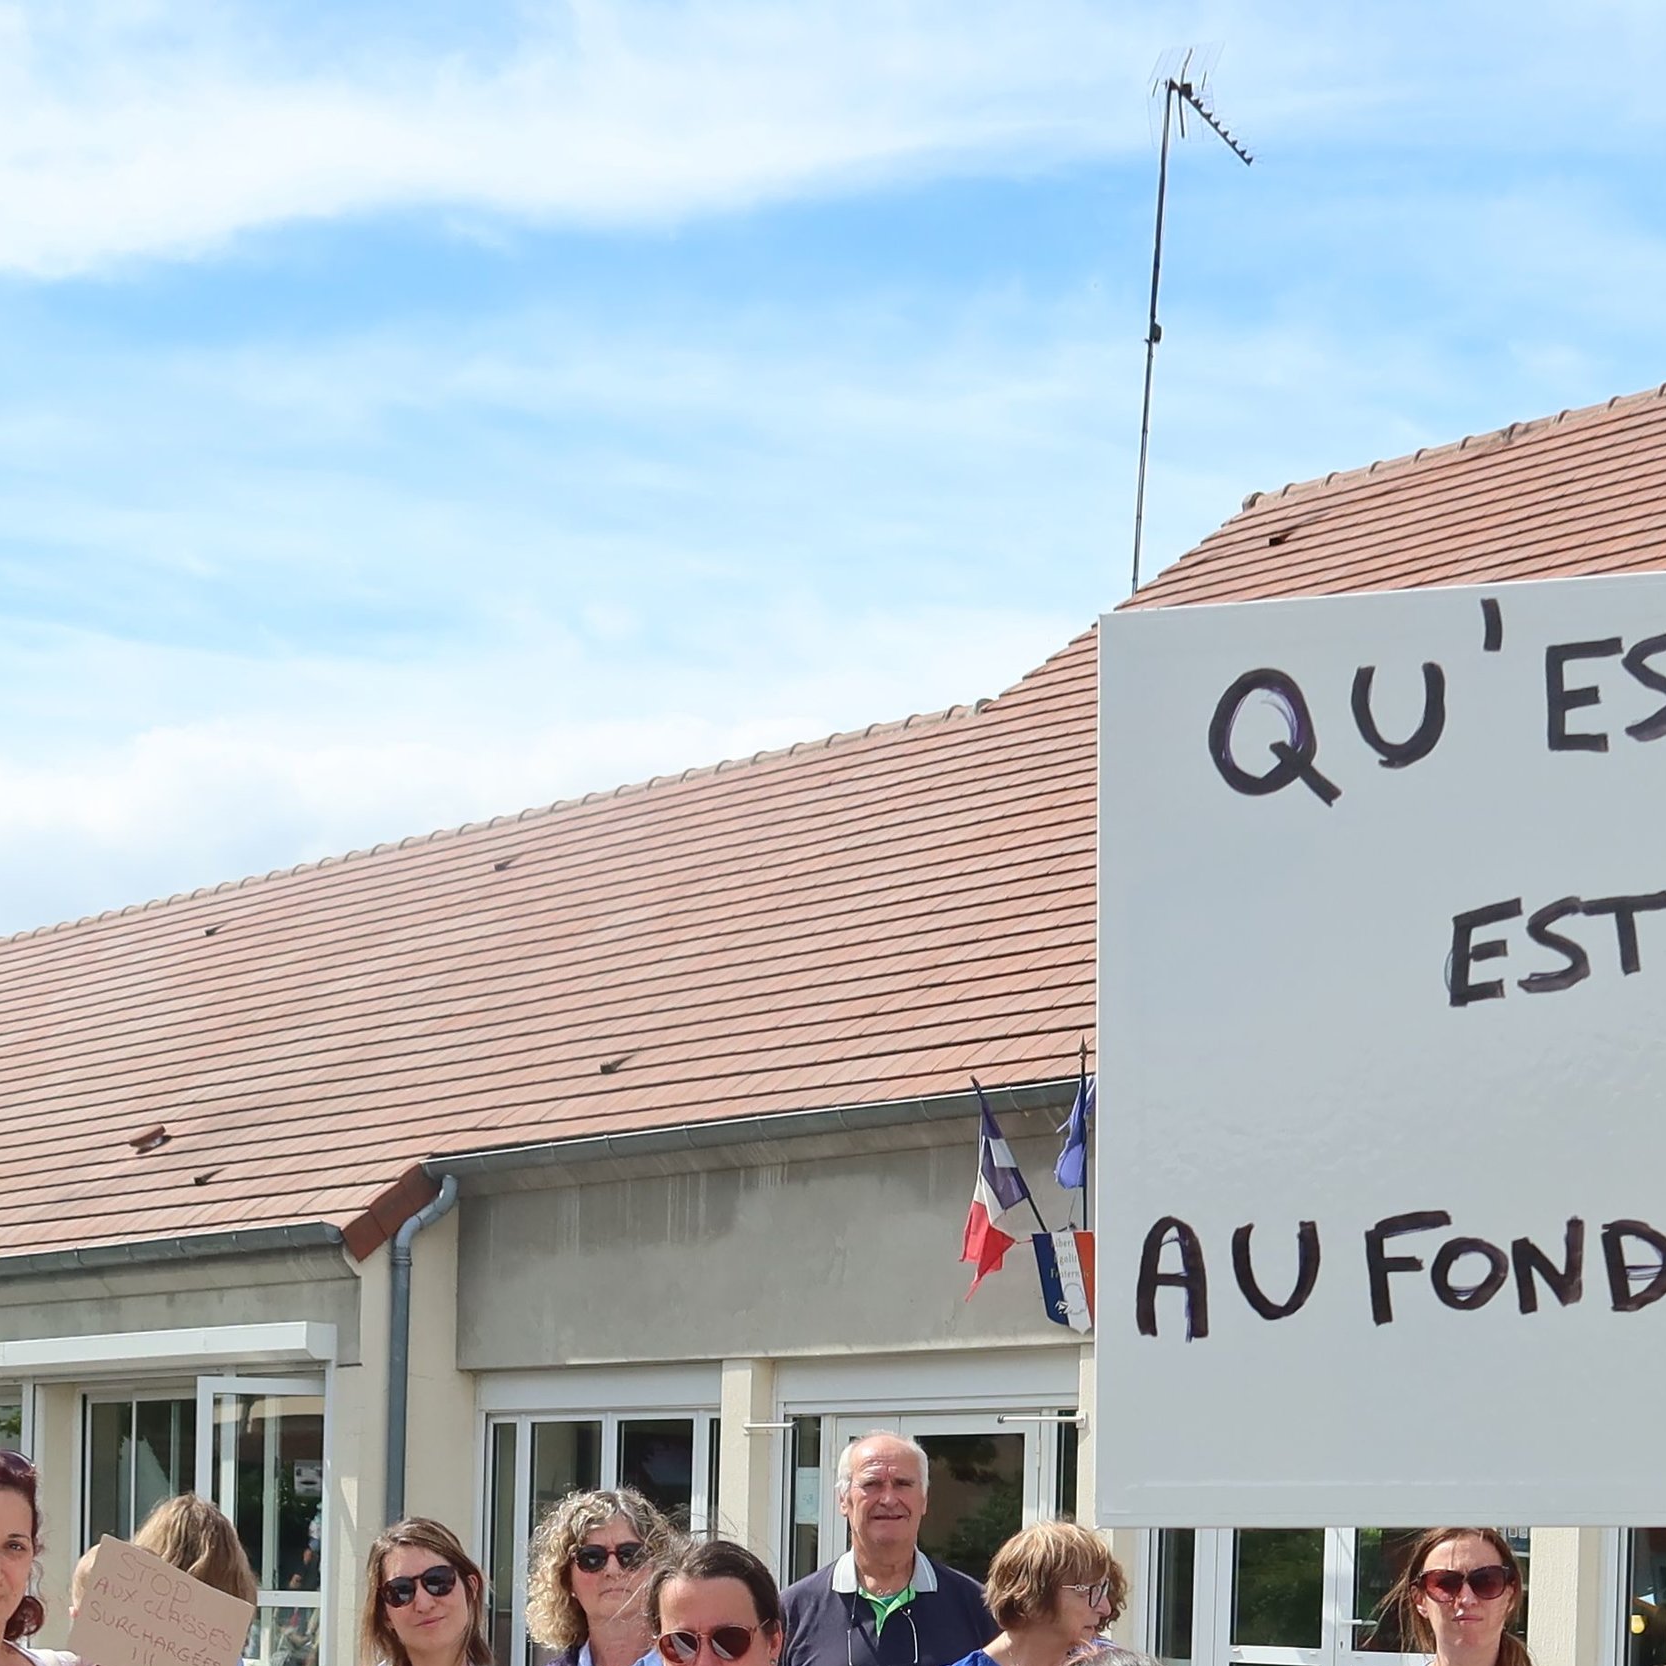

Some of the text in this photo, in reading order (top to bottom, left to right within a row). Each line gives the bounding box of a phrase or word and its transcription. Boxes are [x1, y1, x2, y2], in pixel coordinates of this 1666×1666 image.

[1135, 1215, 1322, 1342] AU
[94, 1576, 233, 1652] AUX CLASSES
[116, 1552, 192, 1612] STOP
